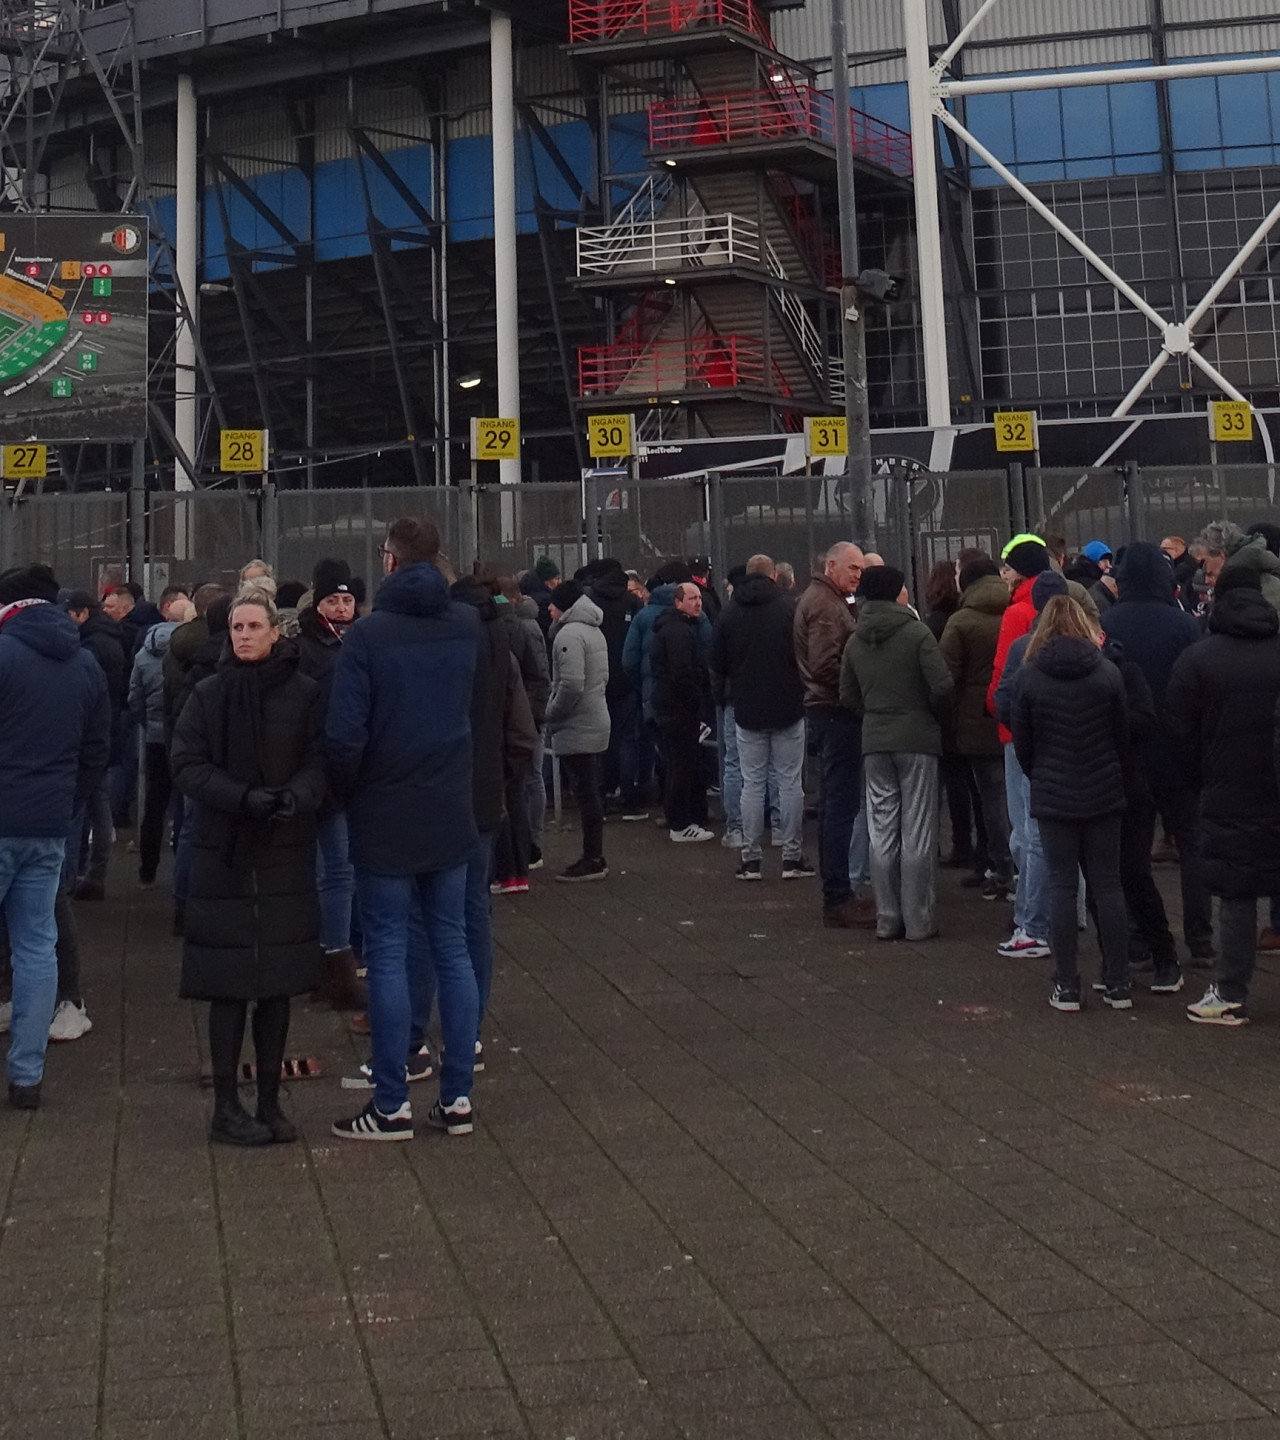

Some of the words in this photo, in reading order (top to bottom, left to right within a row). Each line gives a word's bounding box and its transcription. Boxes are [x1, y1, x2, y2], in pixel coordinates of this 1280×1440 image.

[592, 418, 626, 426] INGANG
[1222, 413, 1245, 431] 33
[485, 430, 511, 449] 29
[597, 427, 622, 447] 30
[818, 429, 838, 447] 31
[1003, 424, 1026, 441] 32
[13, 448, 38, 467] 27
[228, 442, 254, 461] 28
